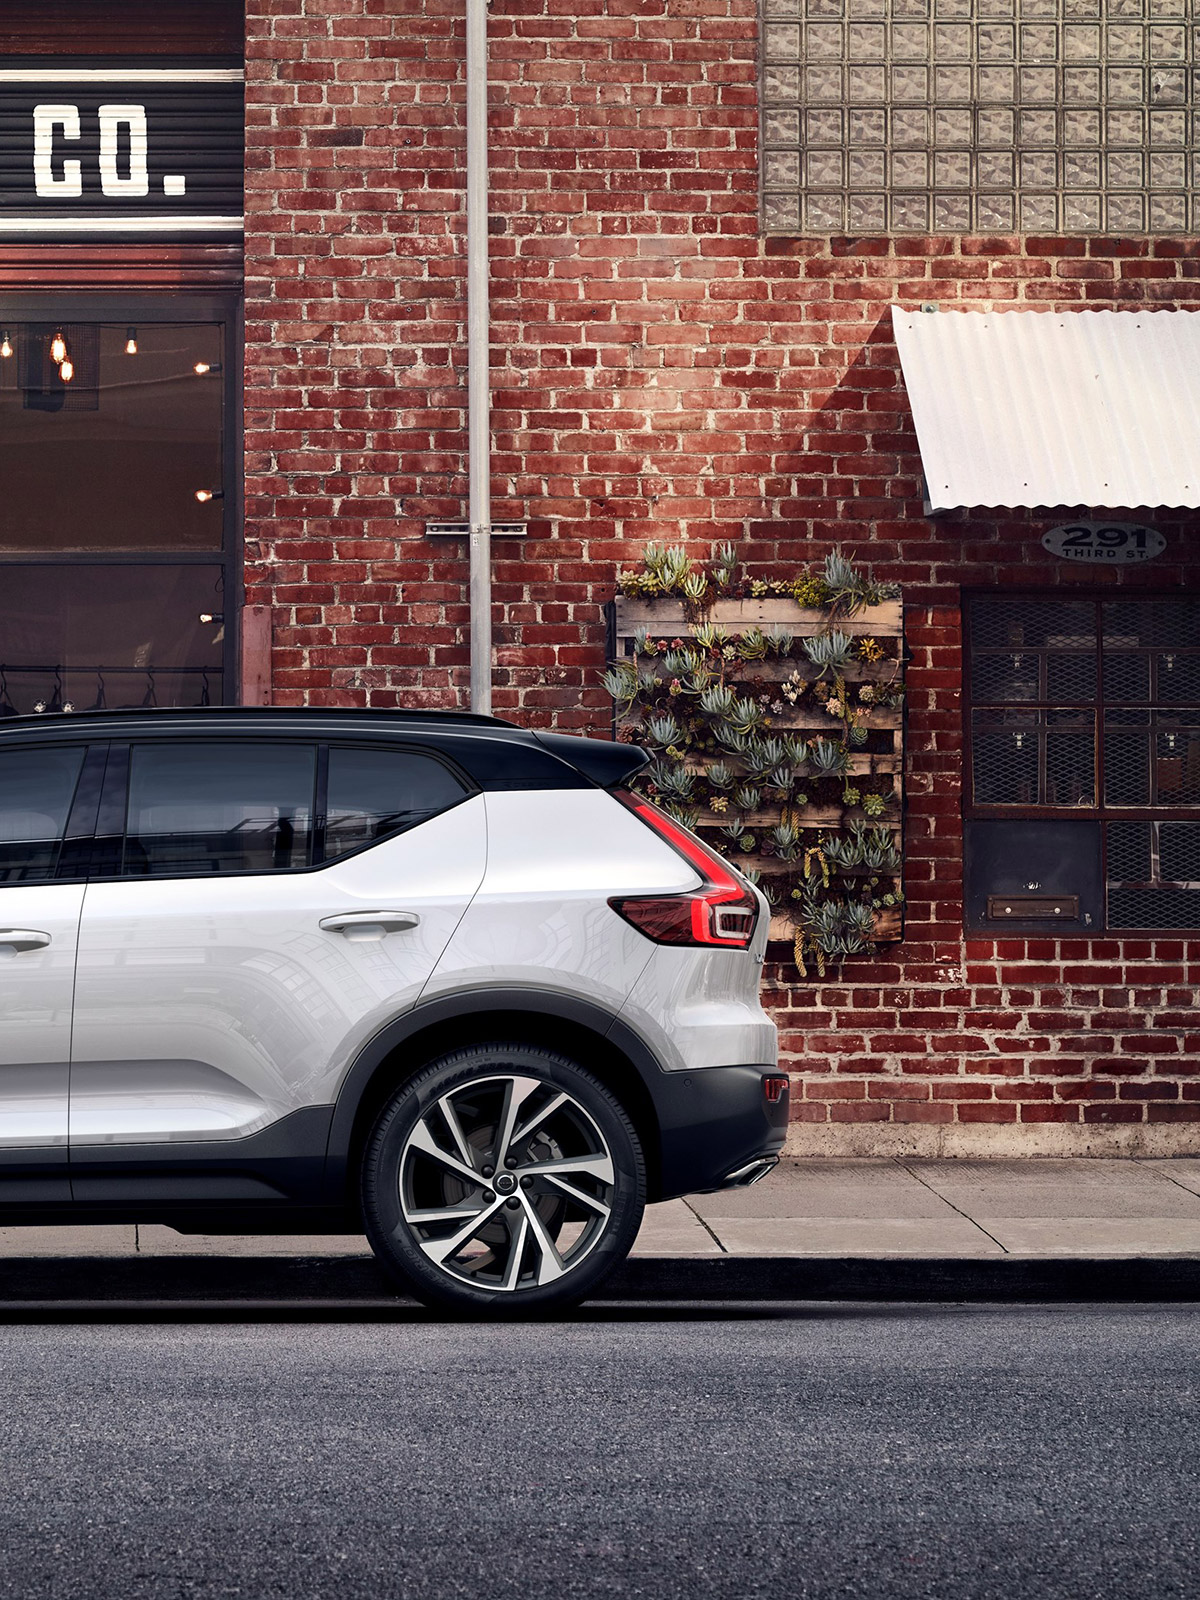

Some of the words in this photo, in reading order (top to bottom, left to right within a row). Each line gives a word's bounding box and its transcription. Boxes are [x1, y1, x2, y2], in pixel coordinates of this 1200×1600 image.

[33, 103, 186, 198] CO.
[1061, 527, 1147, 548] 291
[1062, 548, 1116, 558] THIRD
[1126, 550, 1149, 559] ST.
